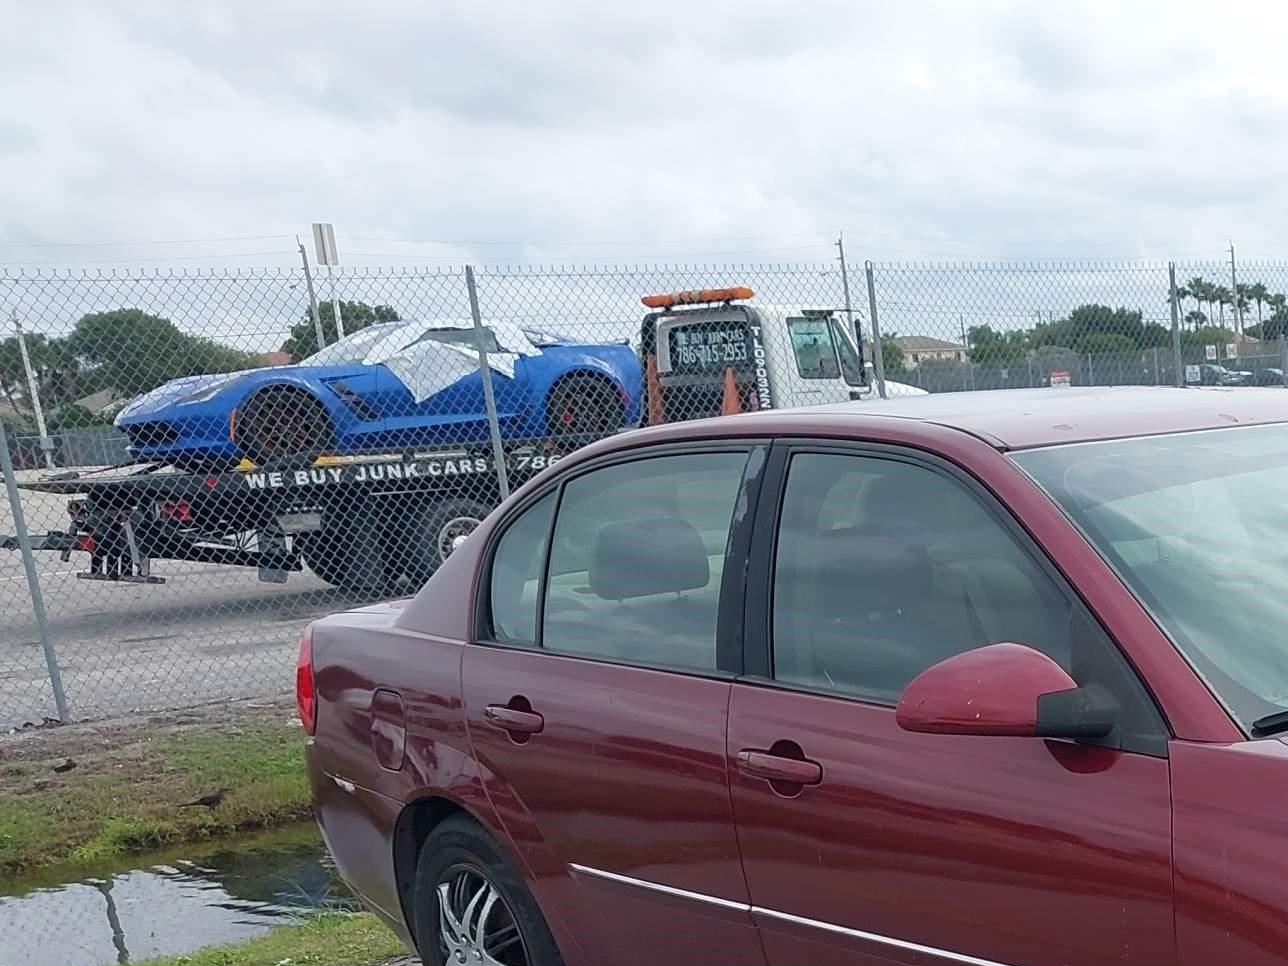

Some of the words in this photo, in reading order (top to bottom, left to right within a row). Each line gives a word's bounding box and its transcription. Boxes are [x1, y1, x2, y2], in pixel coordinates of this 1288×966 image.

[727, 329, 744, 341] CARS
[676, 342, 747, 364] 786-715-2953
[245, 472, 284, 489] WE
[295, 467, 343, 486] BUY
[355, 462, 420, 482] JUNK
[427, 456, 487, 475] CARS
